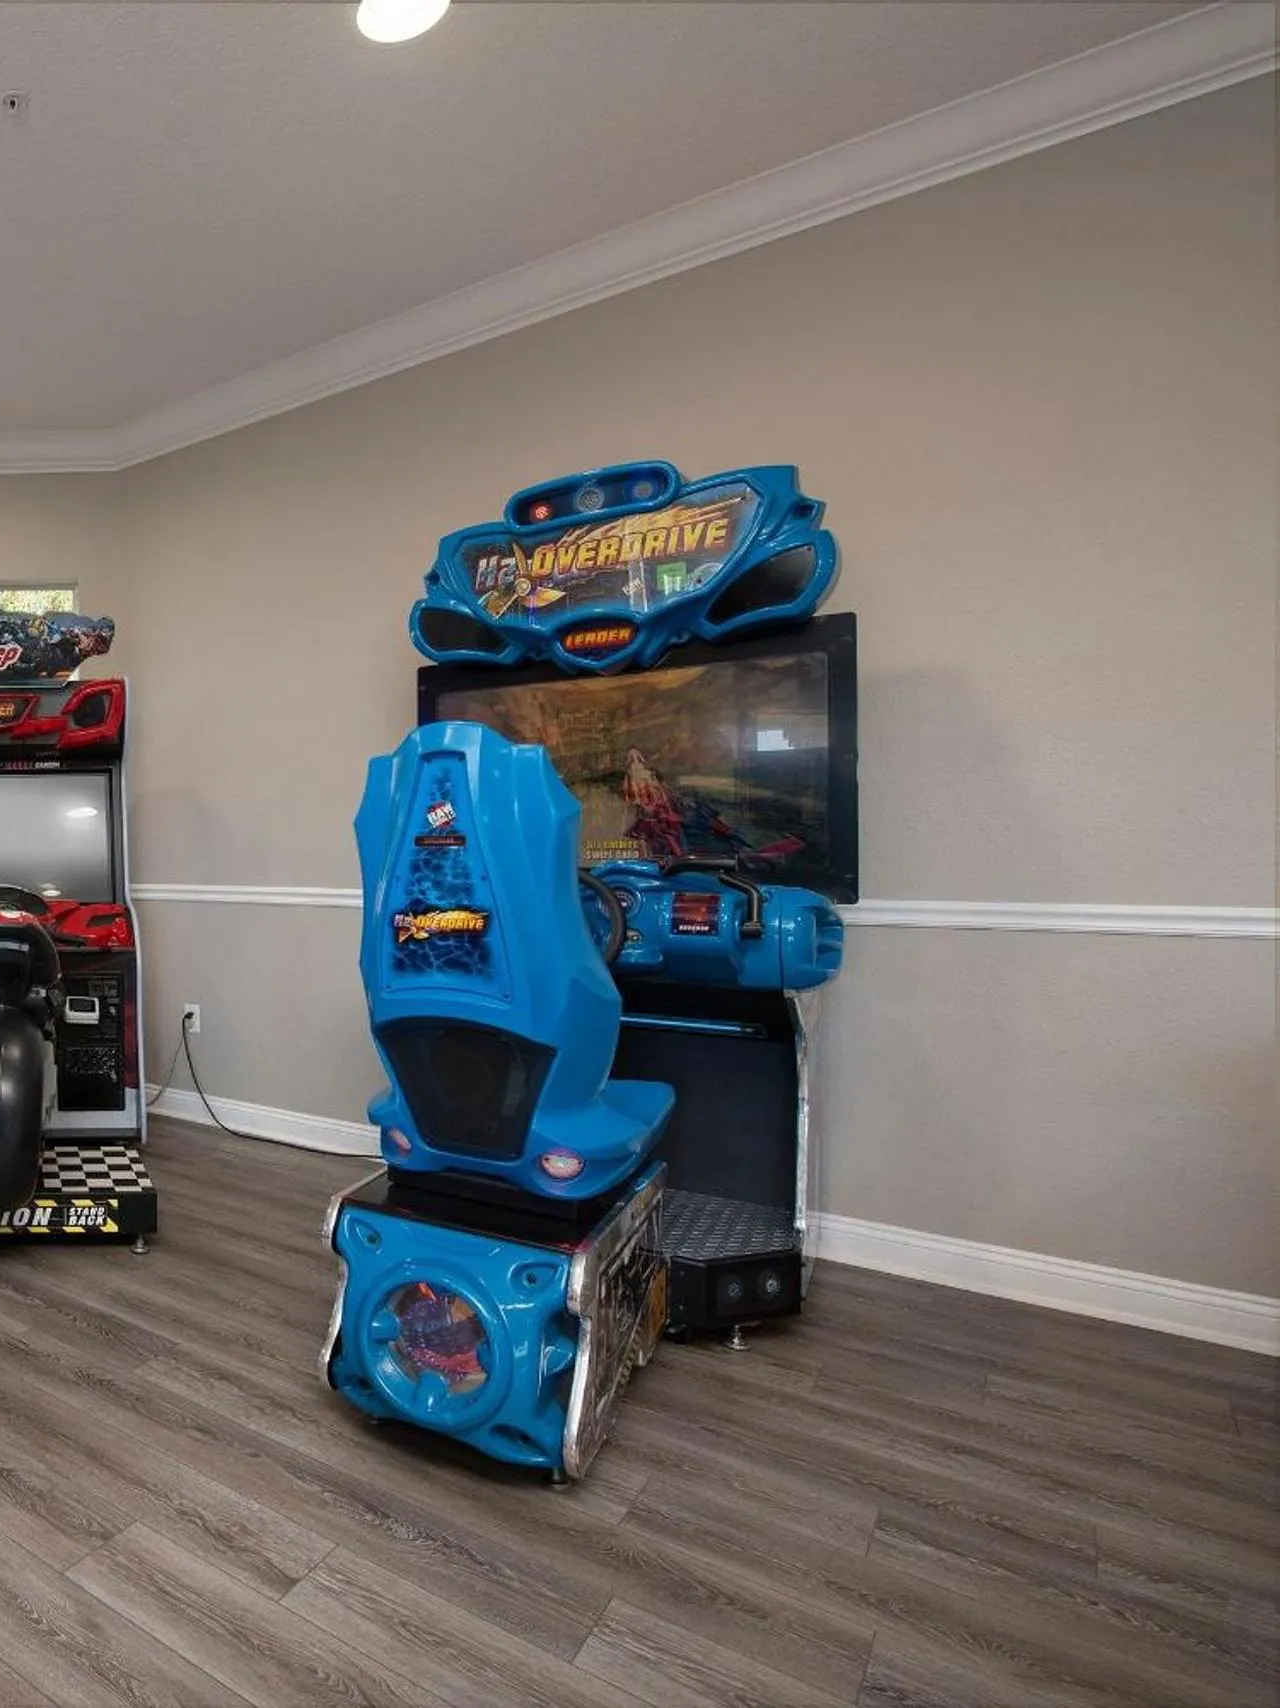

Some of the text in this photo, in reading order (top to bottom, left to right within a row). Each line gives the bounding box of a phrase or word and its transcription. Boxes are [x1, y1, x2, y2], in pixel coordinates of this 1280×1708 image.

[531, 518, 729, 578] OVERDRIVE
[565, 628, 631, 649] LEADER
[69, 1207, 105, 1216] STAND
[68, 1215, 105, 1226] BACK
